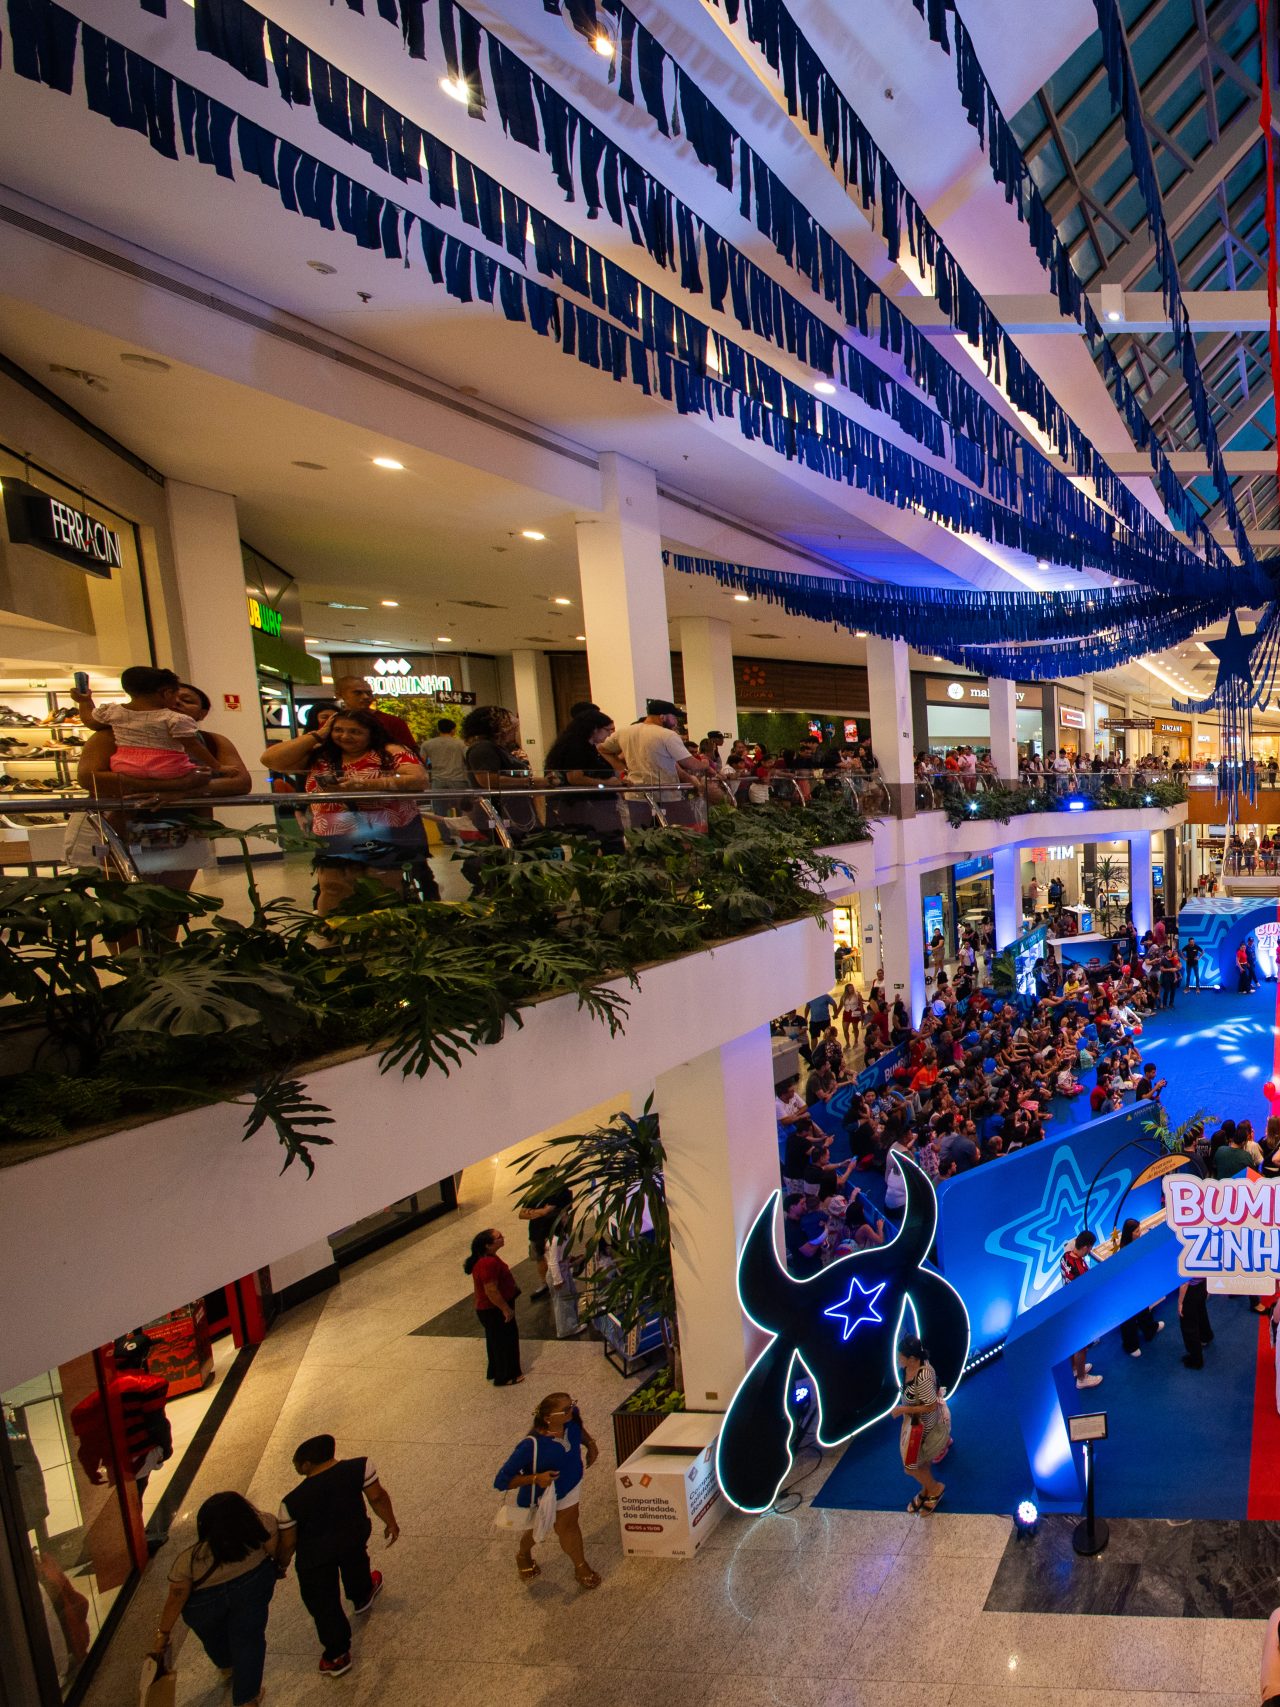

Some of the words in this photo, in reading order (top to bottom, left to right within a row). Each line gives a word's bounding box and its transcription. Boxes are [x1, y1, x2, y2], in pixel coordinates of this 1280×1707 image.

[50, 498, 123, 569] FERRACINI
[247, 597, 282, 637] UBWAY
[1161, 724, 1183, 733] ZINZANE
[1047, 845, 1074, 861] TIM
[621, 1496, 669, 1505] Compartilhe
[622, 1505, 677, 1514] solidariedade,
[639, 1512, 679, 1520] alimentos.
